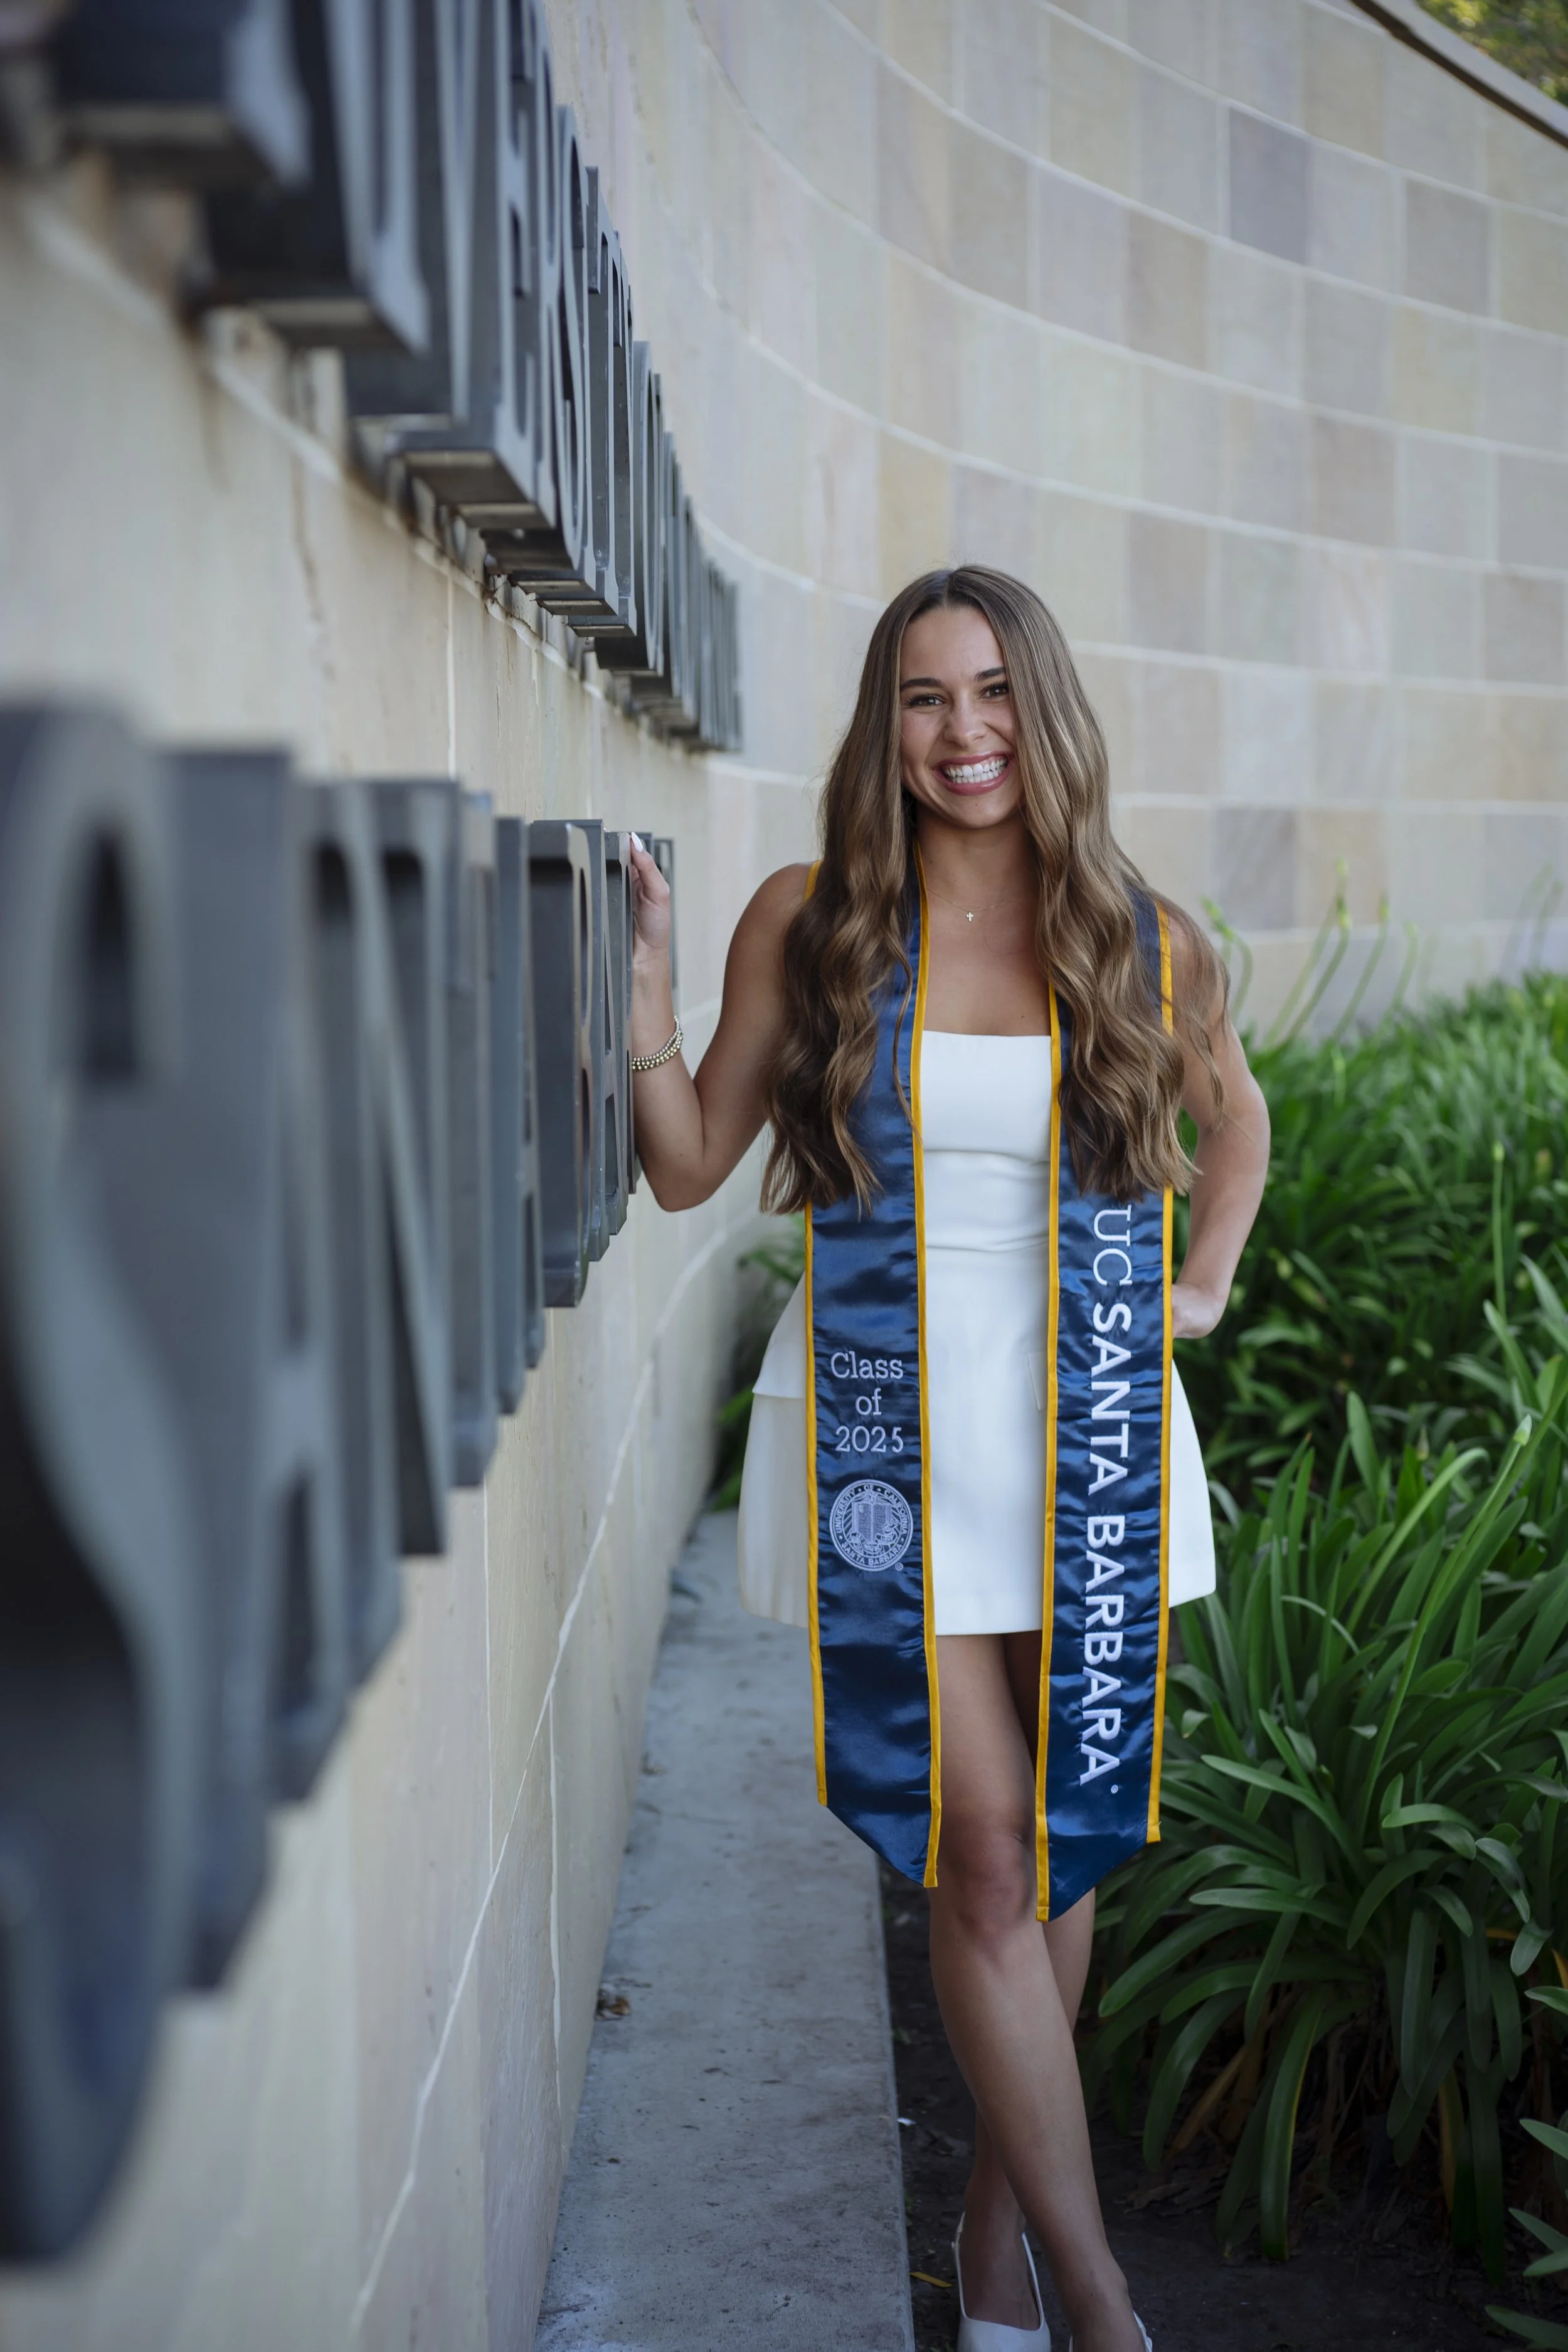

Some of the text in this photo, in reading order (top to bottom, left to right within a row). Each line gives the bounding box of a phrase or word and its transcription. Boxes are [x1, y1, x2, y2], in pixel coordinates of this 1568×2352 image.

[830, 1350, 904, 1379] Class
[855, 1387, 882, 1416] of
[834, 1425, 904, 1453] 2025
[1079, 1204, 1133, 1786] UC SANTA BARBARA
[835, 1488, 856, 1534] UNIVERSITY
[884, 1489, 908, 1535] CALIFORNIA
[841, 1541, 866, 1565] SANTA
[867, 1543, 903, 1566] BARBARA
